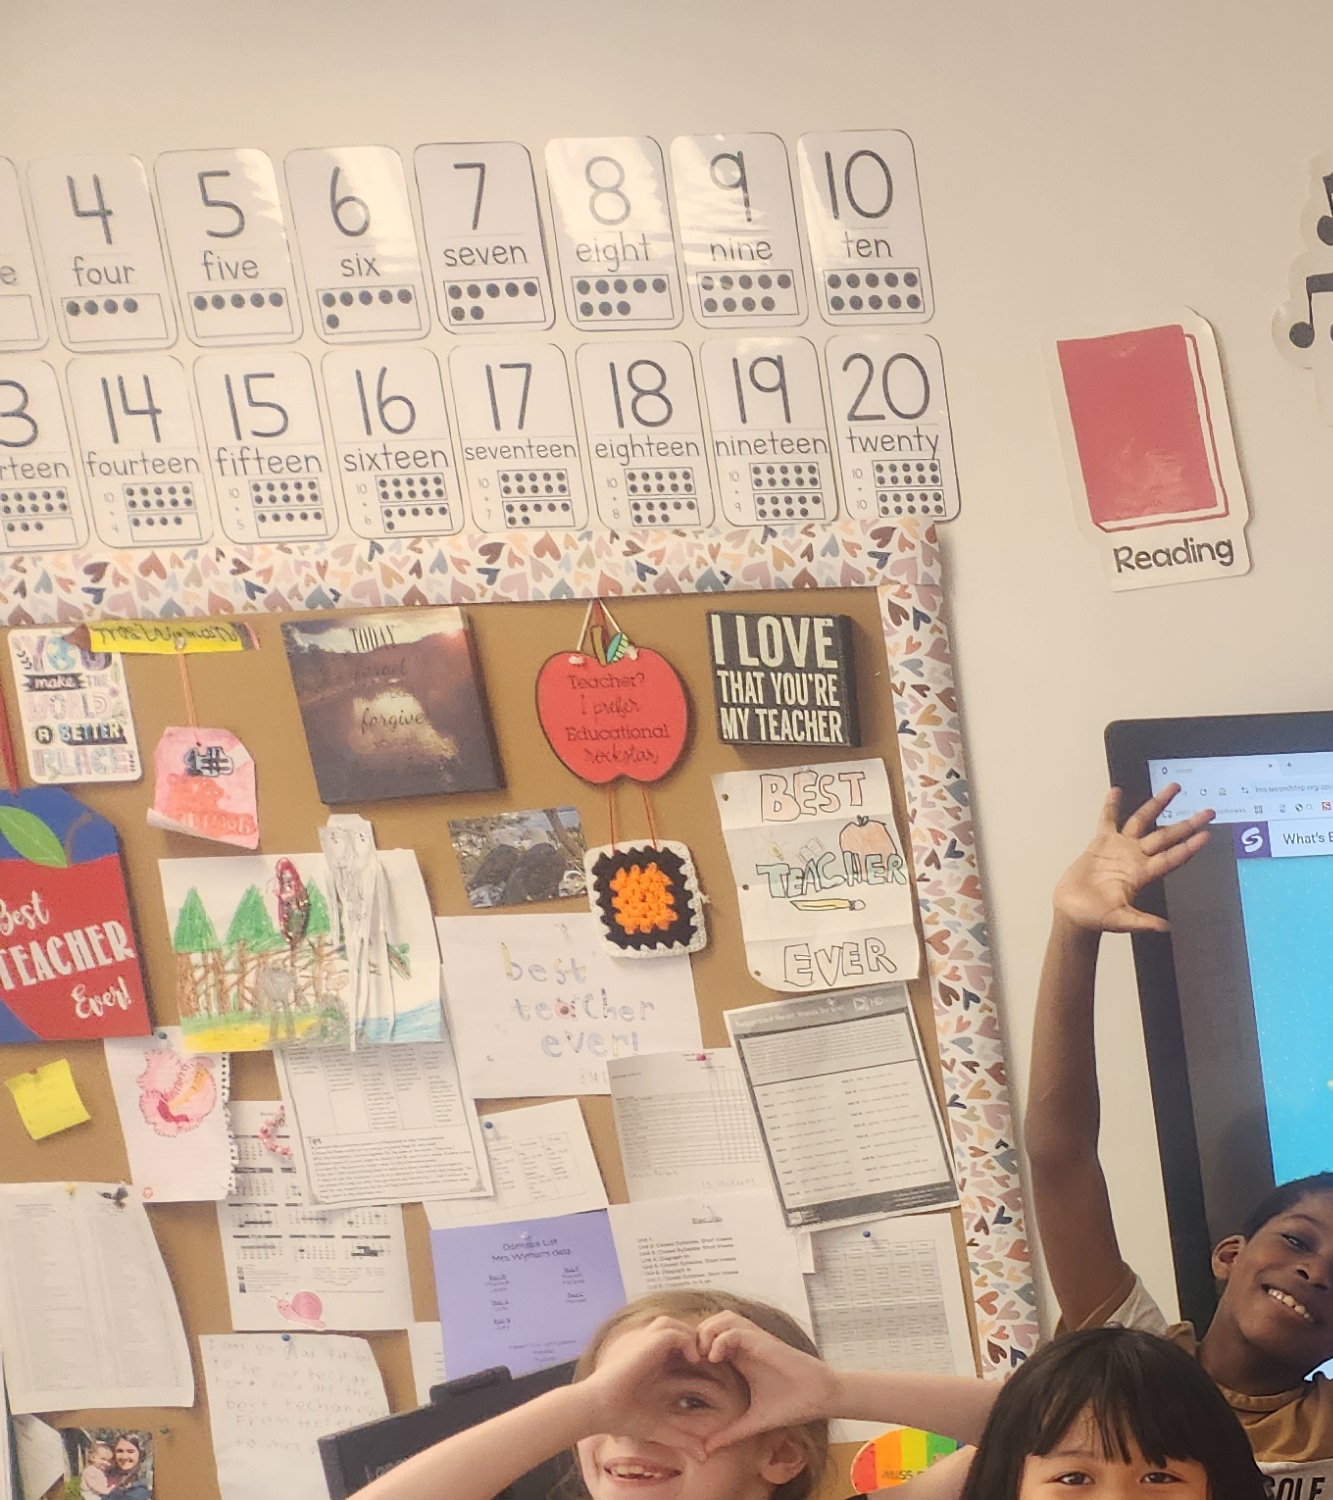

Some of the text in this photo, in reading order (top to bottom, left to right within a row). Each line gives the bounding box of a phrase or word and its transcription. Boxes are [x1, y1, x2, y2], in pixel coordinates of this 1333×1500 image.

[330, 166, 371, 237] 6
[453, 162, 486, 231] 7
[585, 156, 632, 225] 8
[709, 151, 753, 223] 9
[824, 149, 894, 221] 10
[66, 173, 113, 246] 4
[197, 170, 246, 239] 5
[443, 241, 528, 268] seven
[576, 232, 651, 272] eight
[710, 238, 774, 262] nine
[844, 233, 893, 259] ten
[72, 256, 136, 286] four
[201, 250, 260, 282] five
[340, 256, 381, 278] six
[355, 366, 416, 436] 16
[485, 362, 532, 432] 17
[609, 359, 674, 429] 18
[732, 353, 792, 425] 19
[842, 352, 930, 421] 20
[0, 379, 39, 448] 3
[101, 373, 163, 445] 14
[224, 373, 290, 441] 15
[215, 447, 323, 476] fifteen
[343, 444, 449, 472] sixteen
[464, 439, 578, 462] seventeen
[595, 433, 701, 466] eighteen
[714, 430, 829, 458] nineteen
[846, 426, 939, 460] twenty
[0, 456, 70, 480] rteen
[85, 451, 200, 477] fourteen
[1113, 537, 1235, 574] Reading
[711, 614, 838, 669] I LOVE
[34, 677, 76, 690] make
[568, 672, 645, 690] Teacher?
[717, 670, 840, 707] THAT YOU'RE
[24, 693, 113, 721] WORLD
[361, 707, 426, 735] forgive
[720, 707, 843, 743] MY TEACHER
[59, 723, 124, 744] BETTER
[565, 724, 670, 742] Educational
[31, 747, 128, 776] PLACE
[760, 769, 866, 822] BEST
[1283, 832, 1323, 845] What's
[755, 851, 907, 899] TEACHER
[501, 941, 587, 985] best
[784, 937, 897, 987] EVER
[71, 975, 132, 1019] Ever!
